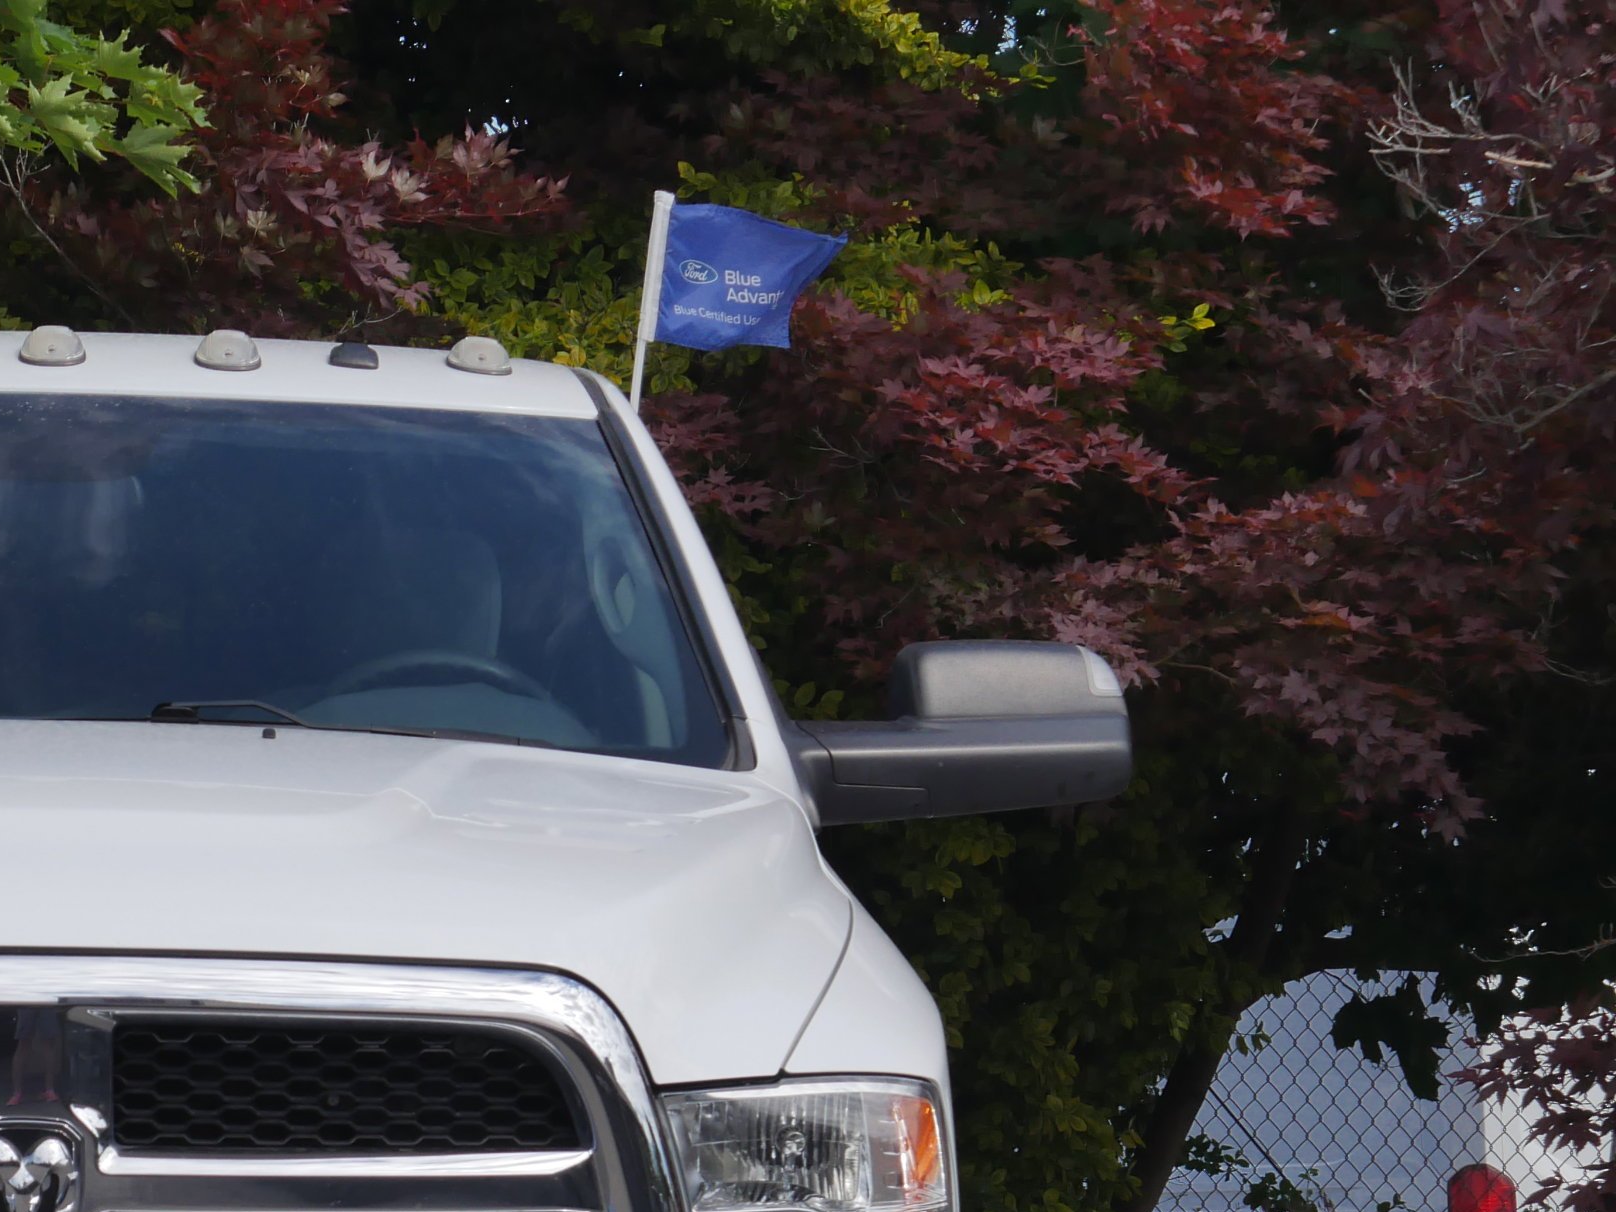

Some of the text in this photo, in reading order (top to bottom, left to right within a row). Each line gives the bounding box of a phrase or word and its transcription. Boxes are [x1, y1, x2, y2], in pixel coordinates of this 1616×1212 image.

[684, 262, 708, 281] Ford
[725, 269, 761, 287] Blue
[674, 304, 697, 316] Blue
[698, 307, 741, 325] Certified
